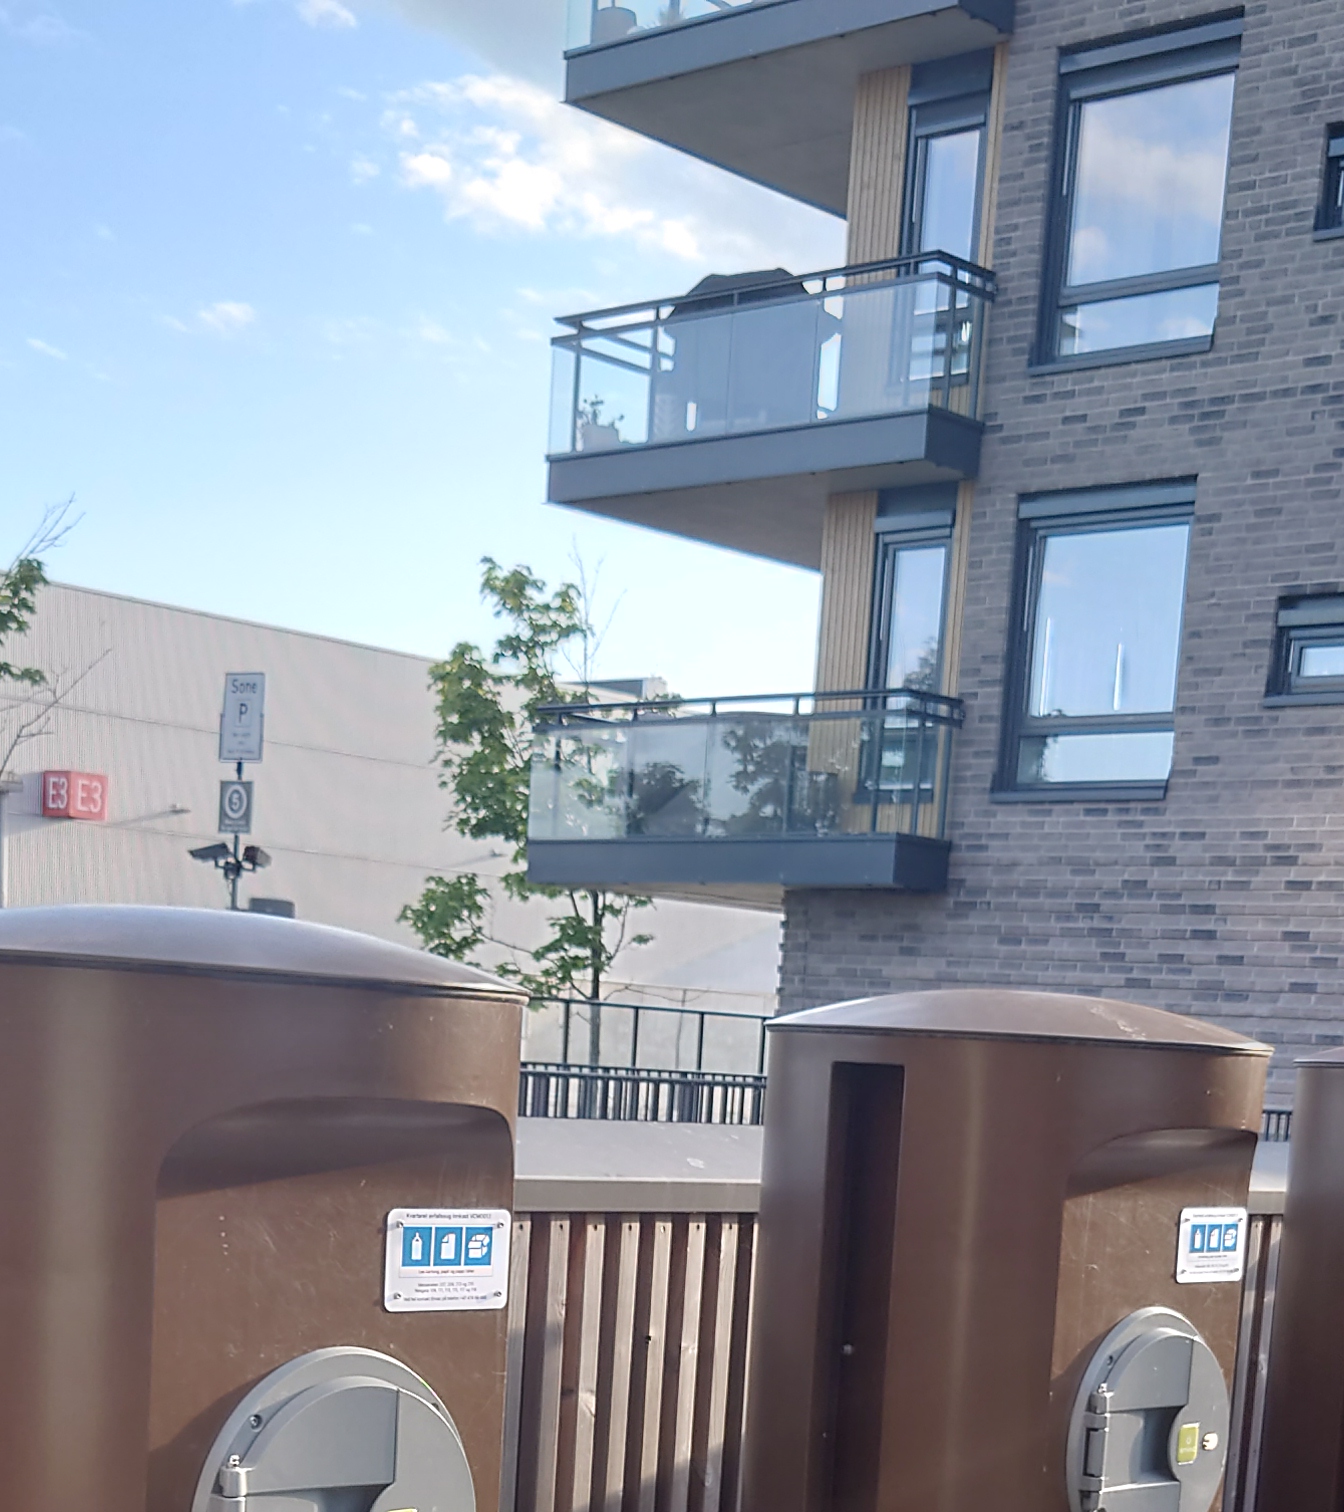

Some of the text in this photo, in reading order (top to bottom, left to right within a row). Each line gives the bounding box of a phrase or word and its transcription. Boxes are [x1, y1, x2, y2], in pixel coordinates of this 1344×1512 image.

[231, 678, 257, 694] Sone
[238, 702, 248, 724] P
[48, 777, 68, 809] E3
[77, 779, 102, 813] E3
